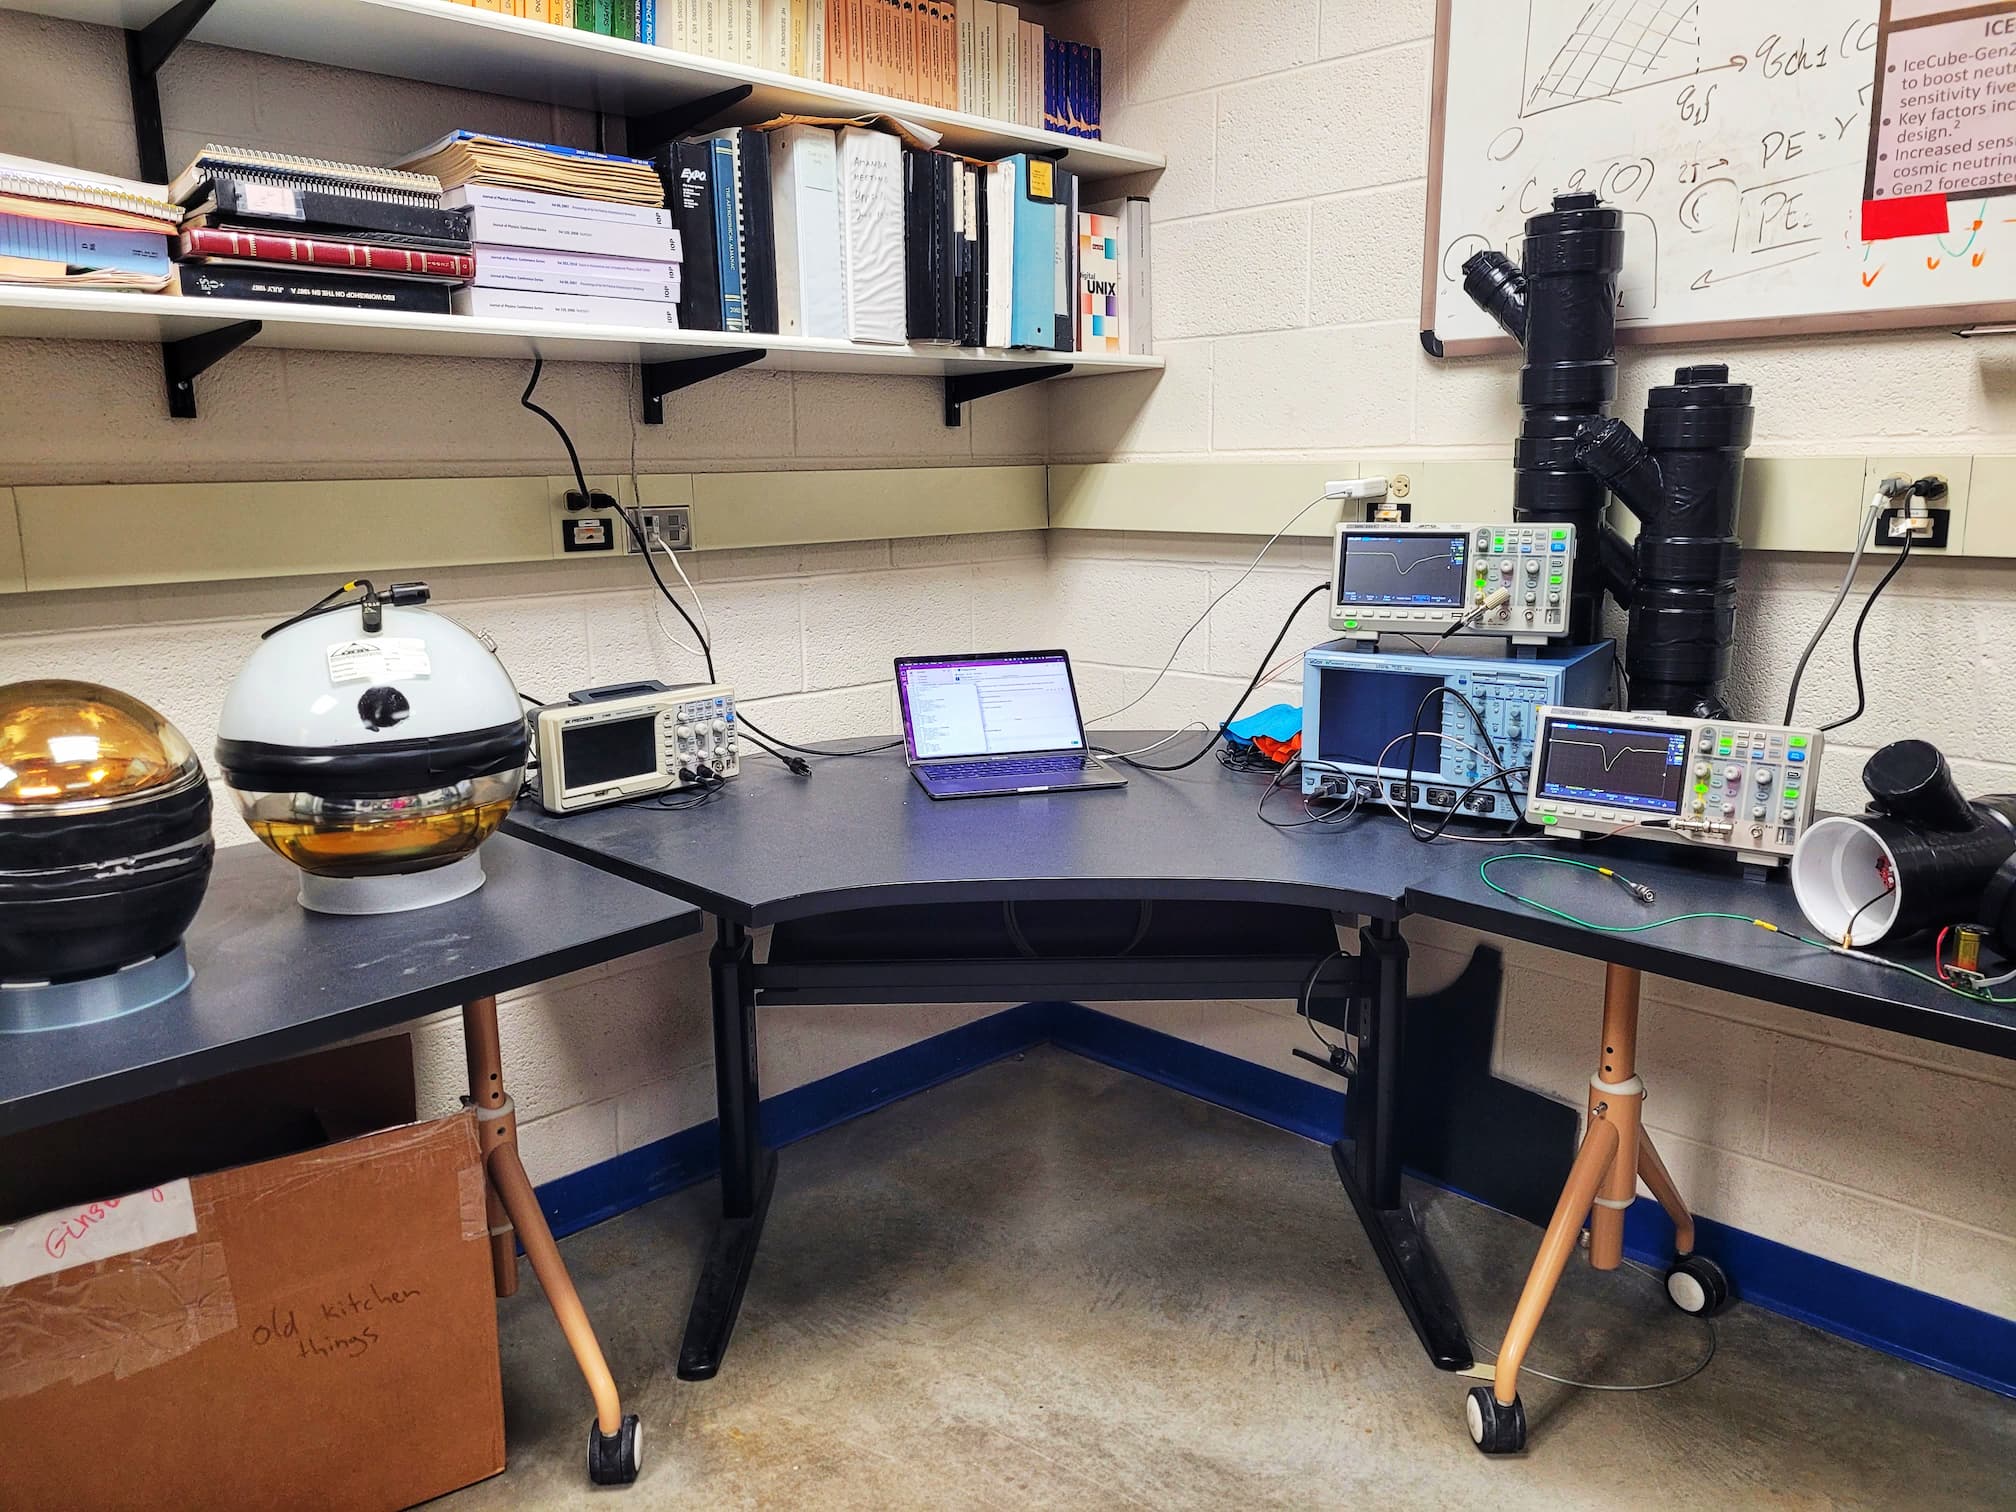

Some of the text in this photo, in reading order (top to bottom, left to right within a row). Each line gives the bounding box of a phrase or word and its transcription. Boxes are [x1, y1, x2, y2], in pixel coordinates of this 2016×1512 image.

[1902, 62, 2016, 90] to boost neut
[1900, 86, 1981, 108] sensitivity
[1899, 110, 1927, 127] Key
[1931, 102, 1986, 122] factors
[1761, 130, 1806, 169] PE
[1895, 138, 1972, 162] Increased
[680, 168, 706, 182] EXPO
[1893, 161, 1950, 178] cosmic
[1892, 180, 1933, 196] Gen2
[267, 286, 284, 294] JULY
[335, 290, 346, 298] ON
[346, 292, 383, 300] WORKSHOP
[1087, 280, 1116, 296] UNIX
[252, 1284, 421, 1347] old kitchen
[298, 1326, 380, 1360] things
